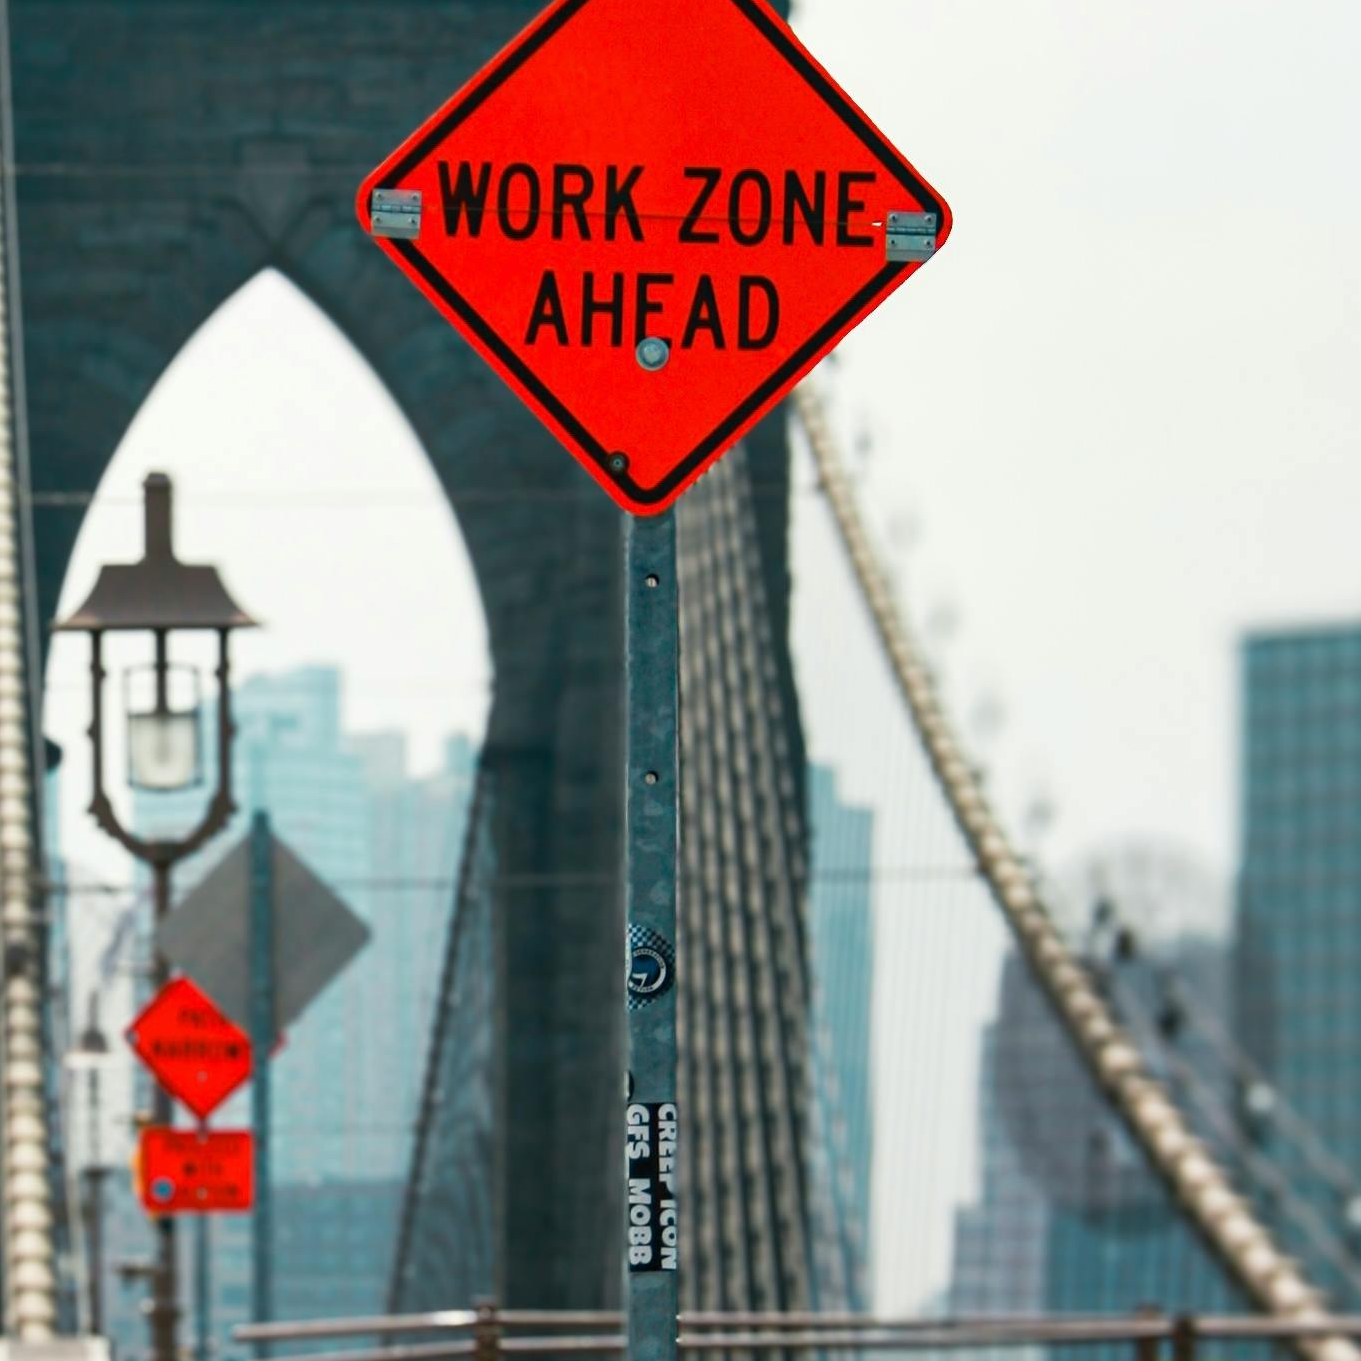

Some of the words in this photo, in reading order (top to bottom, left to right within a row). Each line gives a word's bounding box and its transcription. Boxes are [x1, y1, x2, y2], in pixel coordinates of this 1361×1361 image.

[438, 160, 644, 241] WORK
[678, 167, 878, 247] ZONE
[524, 271, 780, 351] AHEAD
[627, 1103, 650, 1160] GFS
[629, 1178, 652, 1266] MOBB
[659, 1199, 677, 1270] ICON
